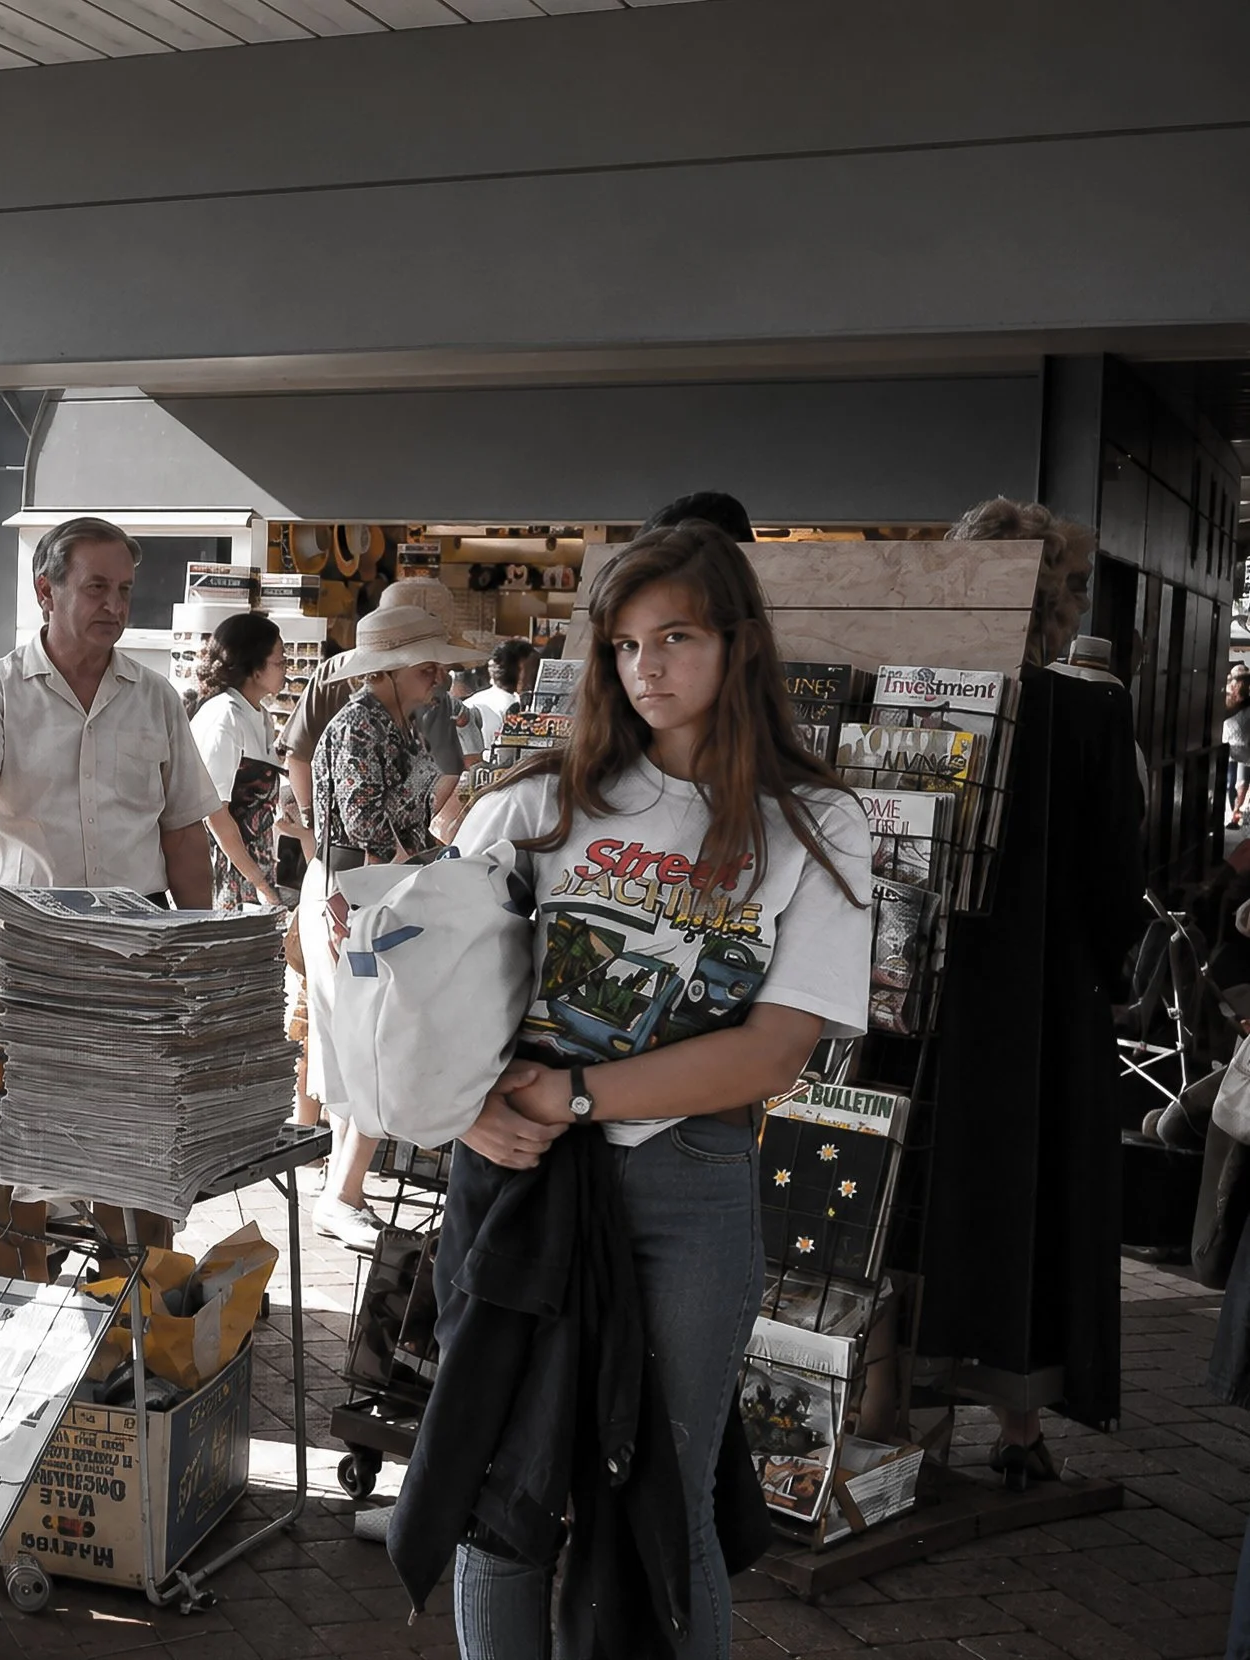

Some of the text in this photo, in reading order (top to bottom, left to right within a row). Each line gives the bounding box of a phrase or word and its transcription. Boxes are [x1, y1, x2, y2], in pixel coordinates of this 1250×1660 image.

[883, 674, 997, 699] Investment
[574, 838, 754, 892] Street
[810, 1083, 894, 1119] BULLETIN
